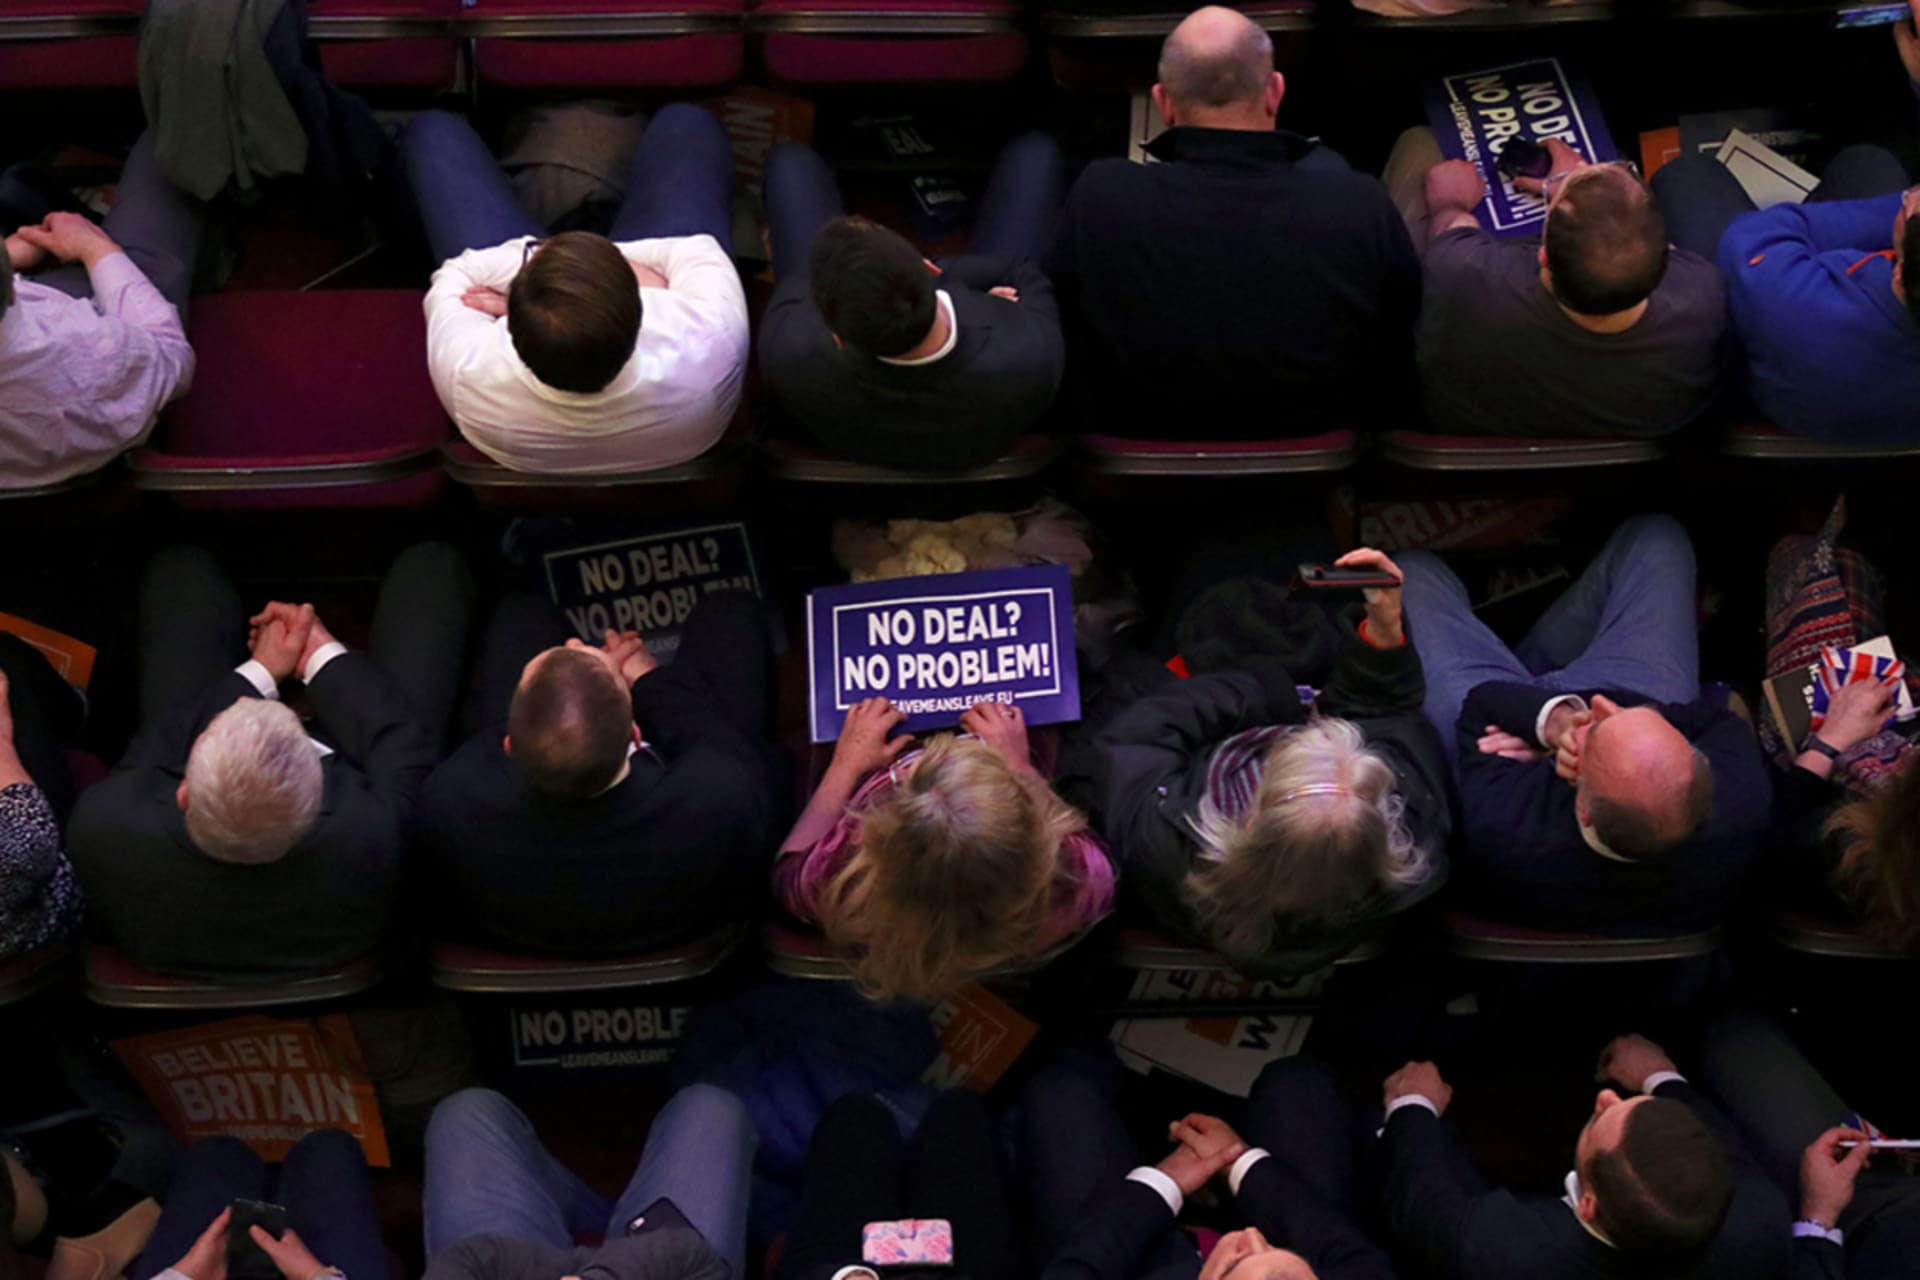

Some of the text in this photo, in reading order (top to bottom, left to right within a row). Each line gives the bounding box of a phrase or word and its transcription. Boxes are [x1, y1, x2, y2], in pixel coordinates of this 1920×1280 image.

[1464, 73, 1512, 104] NO
[1515, 80, 1563, 116] NO
[577, 536, 720, 597] NO DEAL?
[868, 601, 1022, 647] NO DEAL?
[843, 643, 1051, 691] NO PROBLEM!
[519, 1011, 567, 1049] NO
[151, 1032, 308, 1077] BELIEVE
[170, 1071, 360, 1126] BRITAIN
